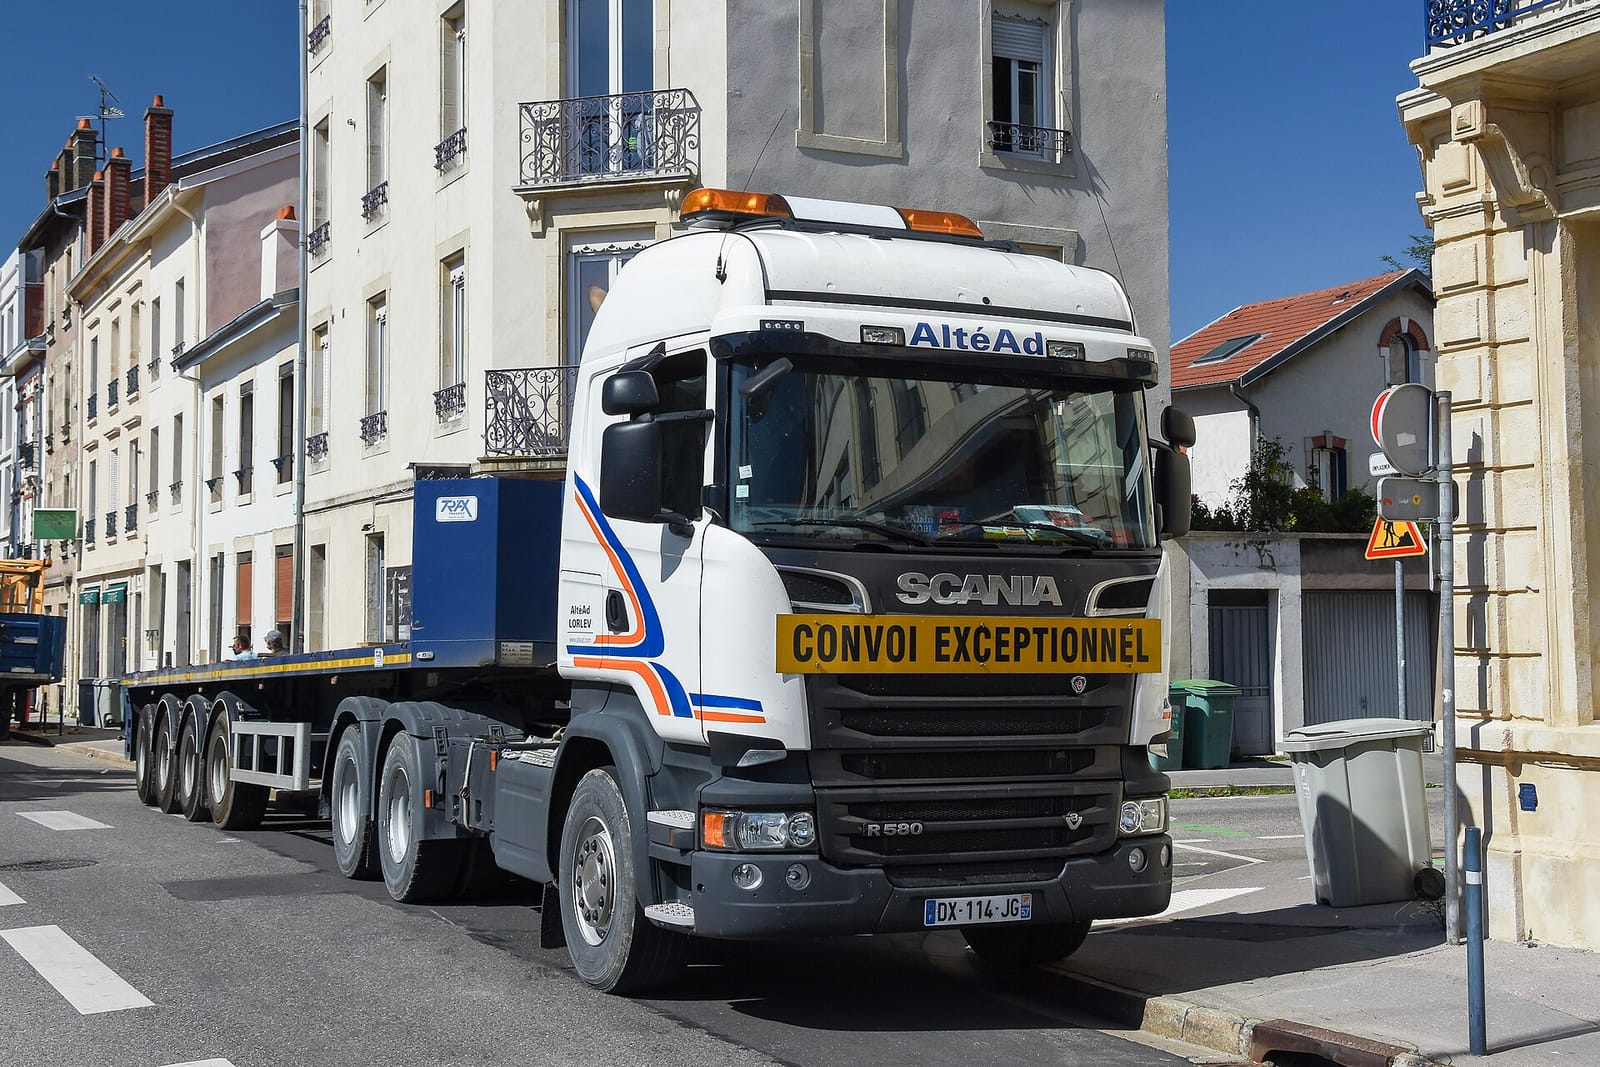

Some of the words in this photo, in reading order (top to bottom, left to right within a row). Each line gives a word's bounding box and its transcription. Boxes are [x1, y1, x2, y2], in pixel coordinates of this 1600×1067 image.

[909, 322, 1044, 356] AltéAd
[441, 499, 472, 518] TRAX
[895, 572, 1063, 607] SCANIA
[570, 605, 591, 615] AltéAd
[568, 618, 592, 629] LORLEV
[792, 623, 917, 663] CONVOI
[935, 625, 1150, 663] EXCEPTIONNEL
[867, 824, 881, 837] R
[883, 822, 924, 836] 580
[937, 898, 1020, 922] DX-114-JG
[1021, 907, 1030, 918] 57
